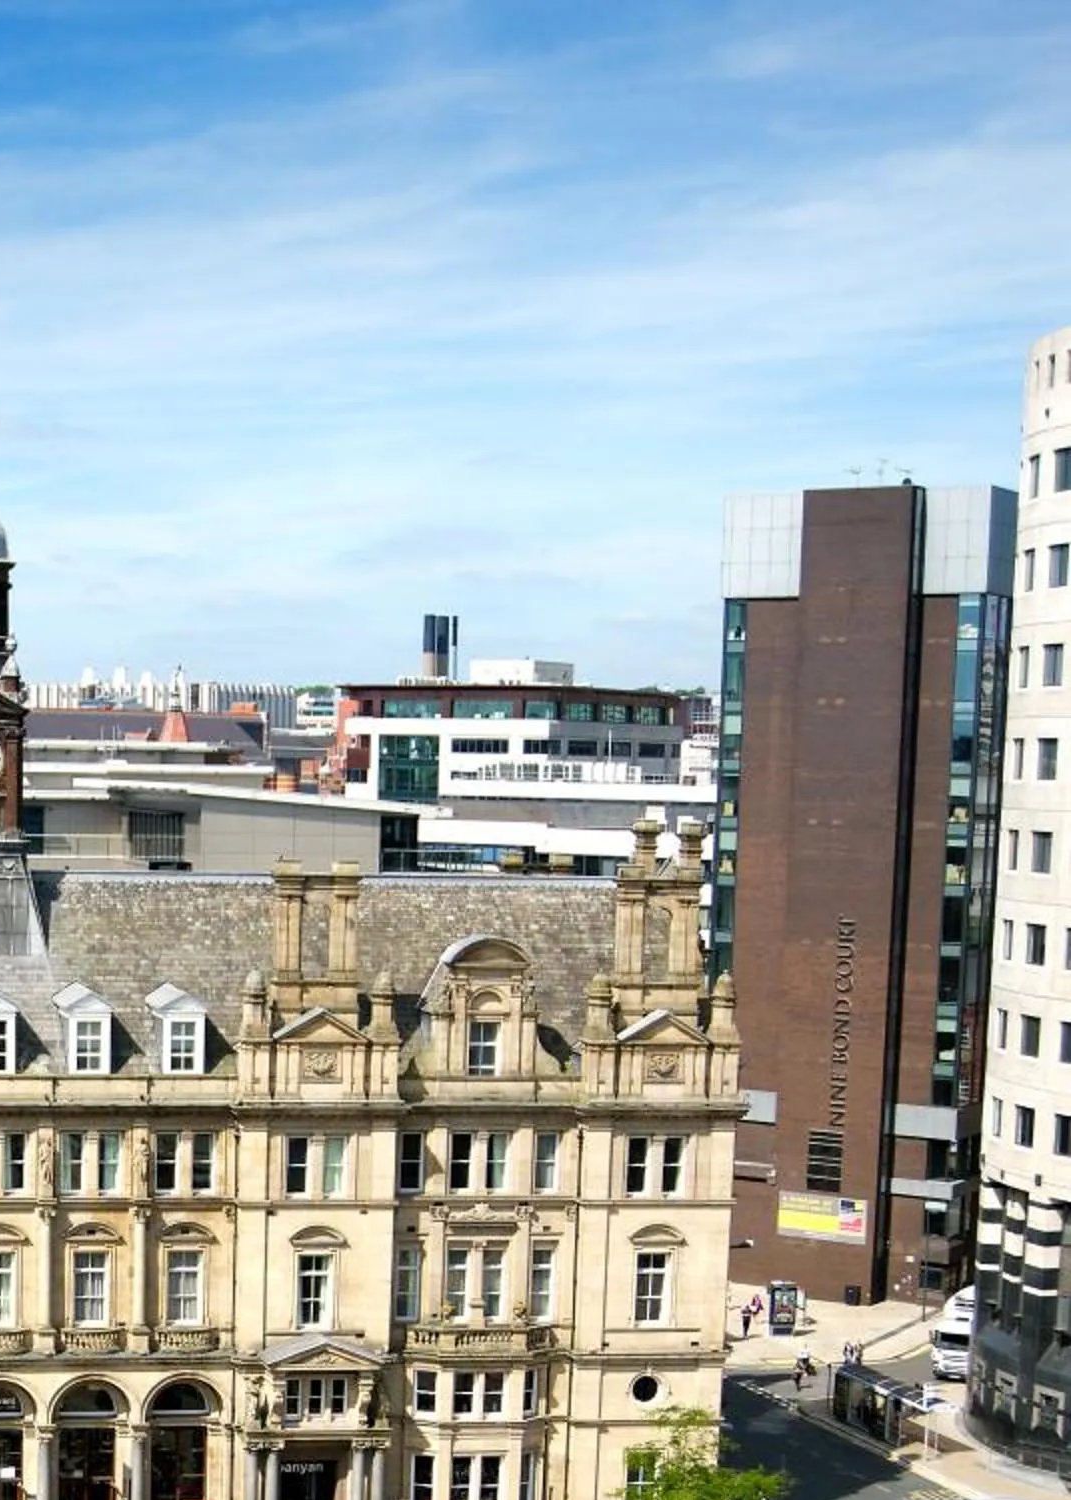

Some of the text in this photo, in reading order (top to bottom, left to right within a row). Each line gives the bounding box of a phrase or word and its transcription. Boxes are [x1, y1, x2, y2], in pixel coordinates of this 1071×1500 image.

[830, 914, 856, 1128] NINE BOND COURT
